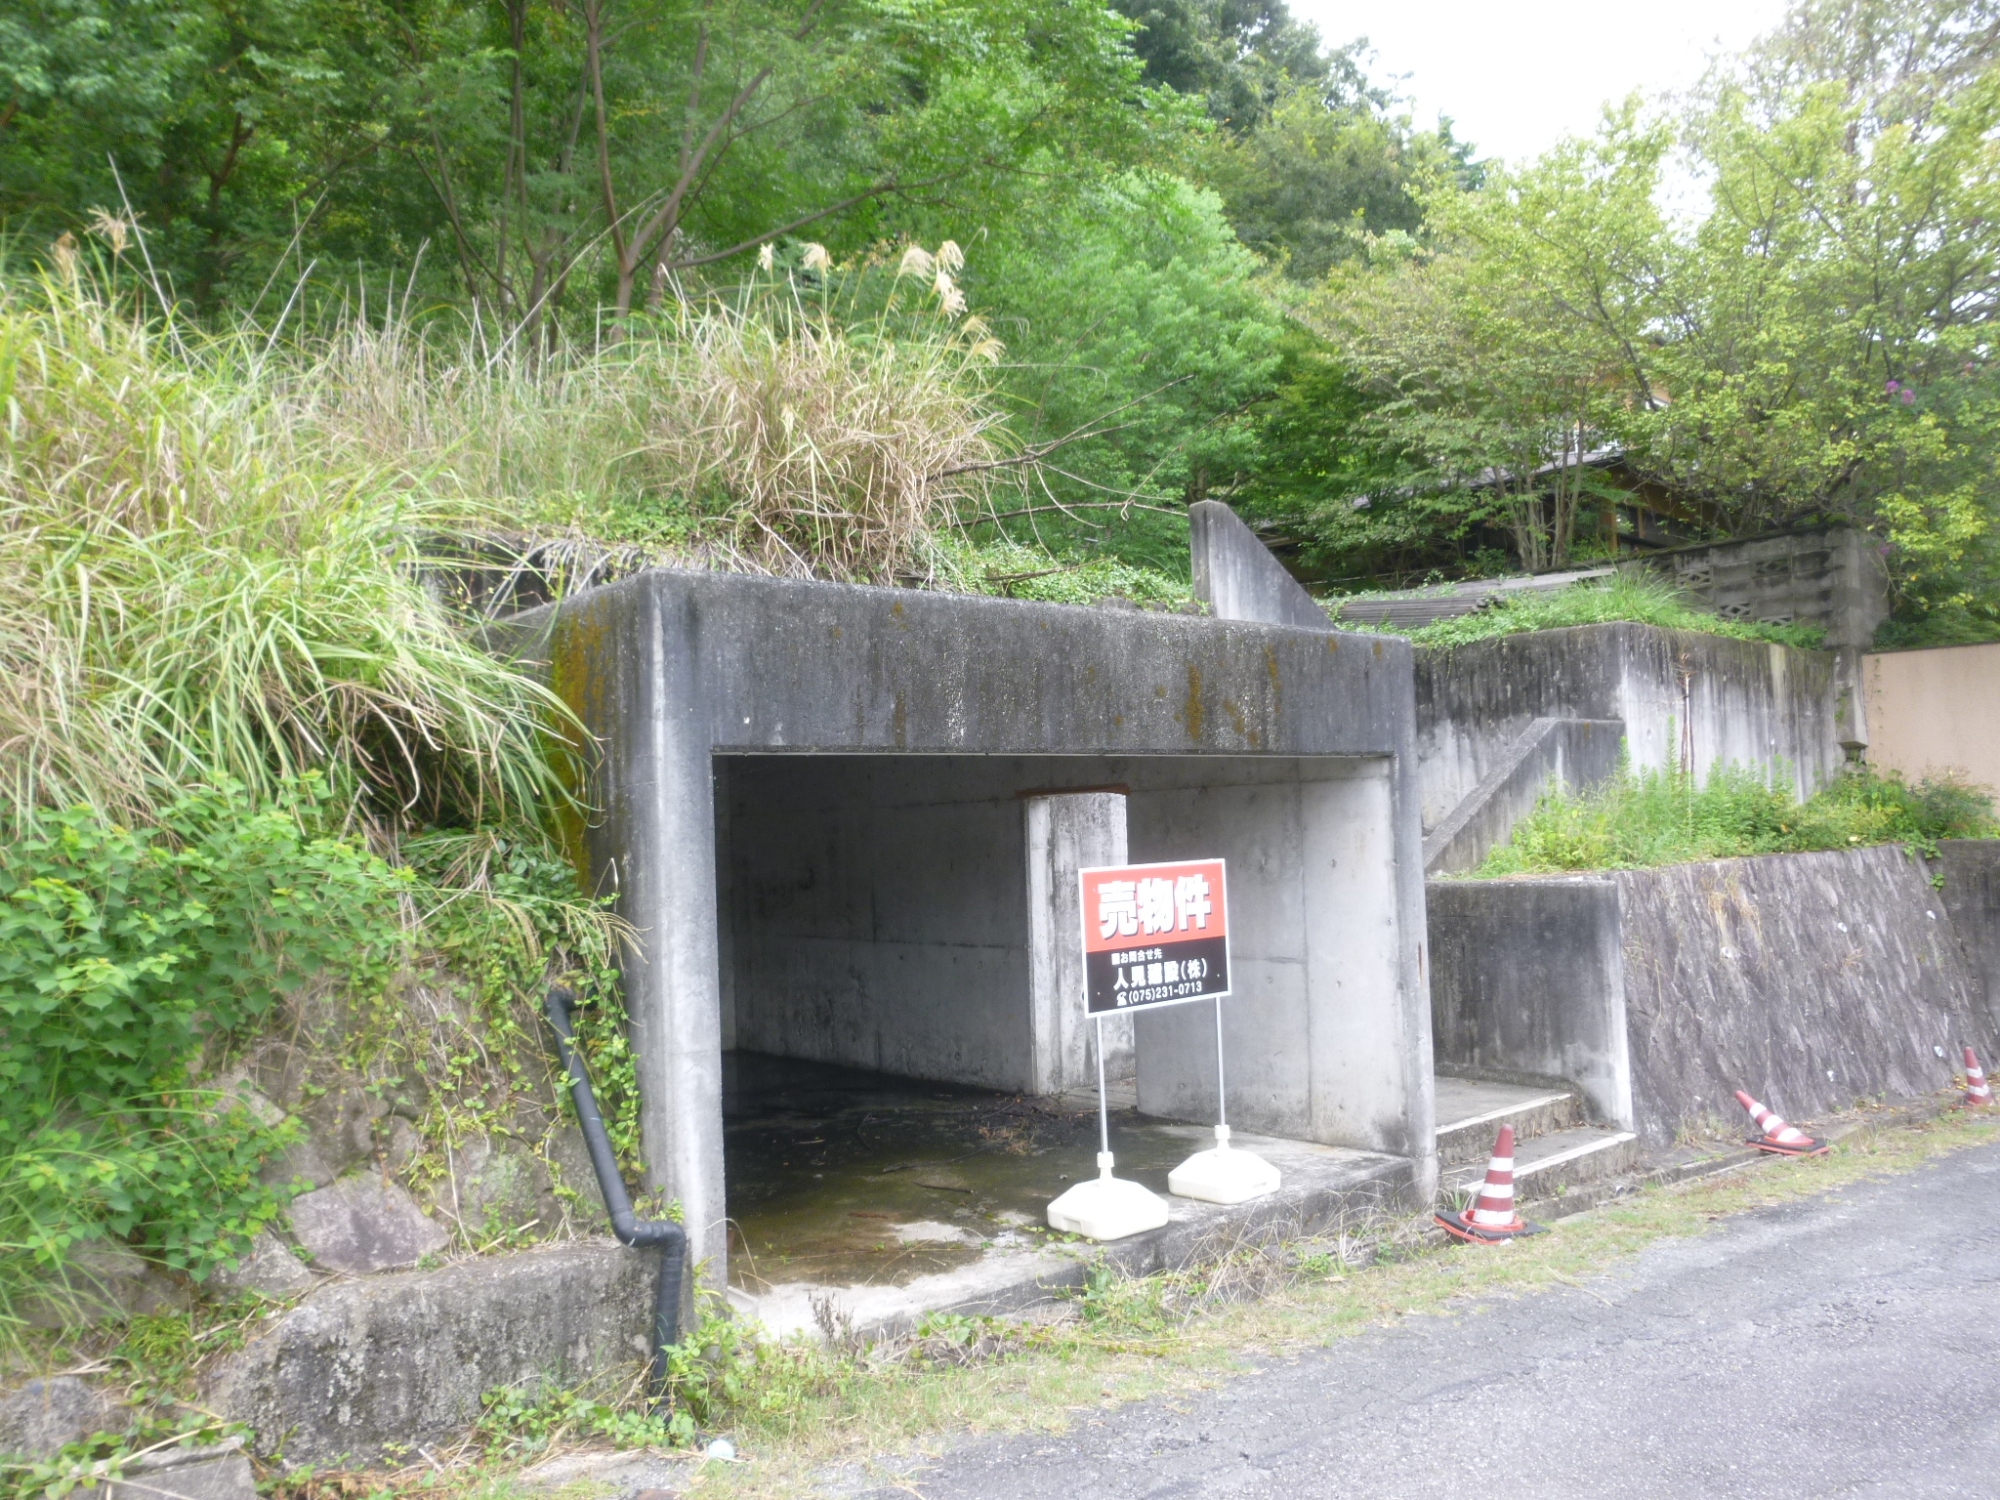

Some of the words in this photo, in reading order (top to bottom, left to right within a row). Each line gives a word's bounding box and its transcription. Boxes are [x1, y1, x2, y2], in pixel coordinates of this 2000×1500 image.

[1098, 874, 1212, 940] 売物件
[1128, 980, 1202, 1005] (075)231-0713
